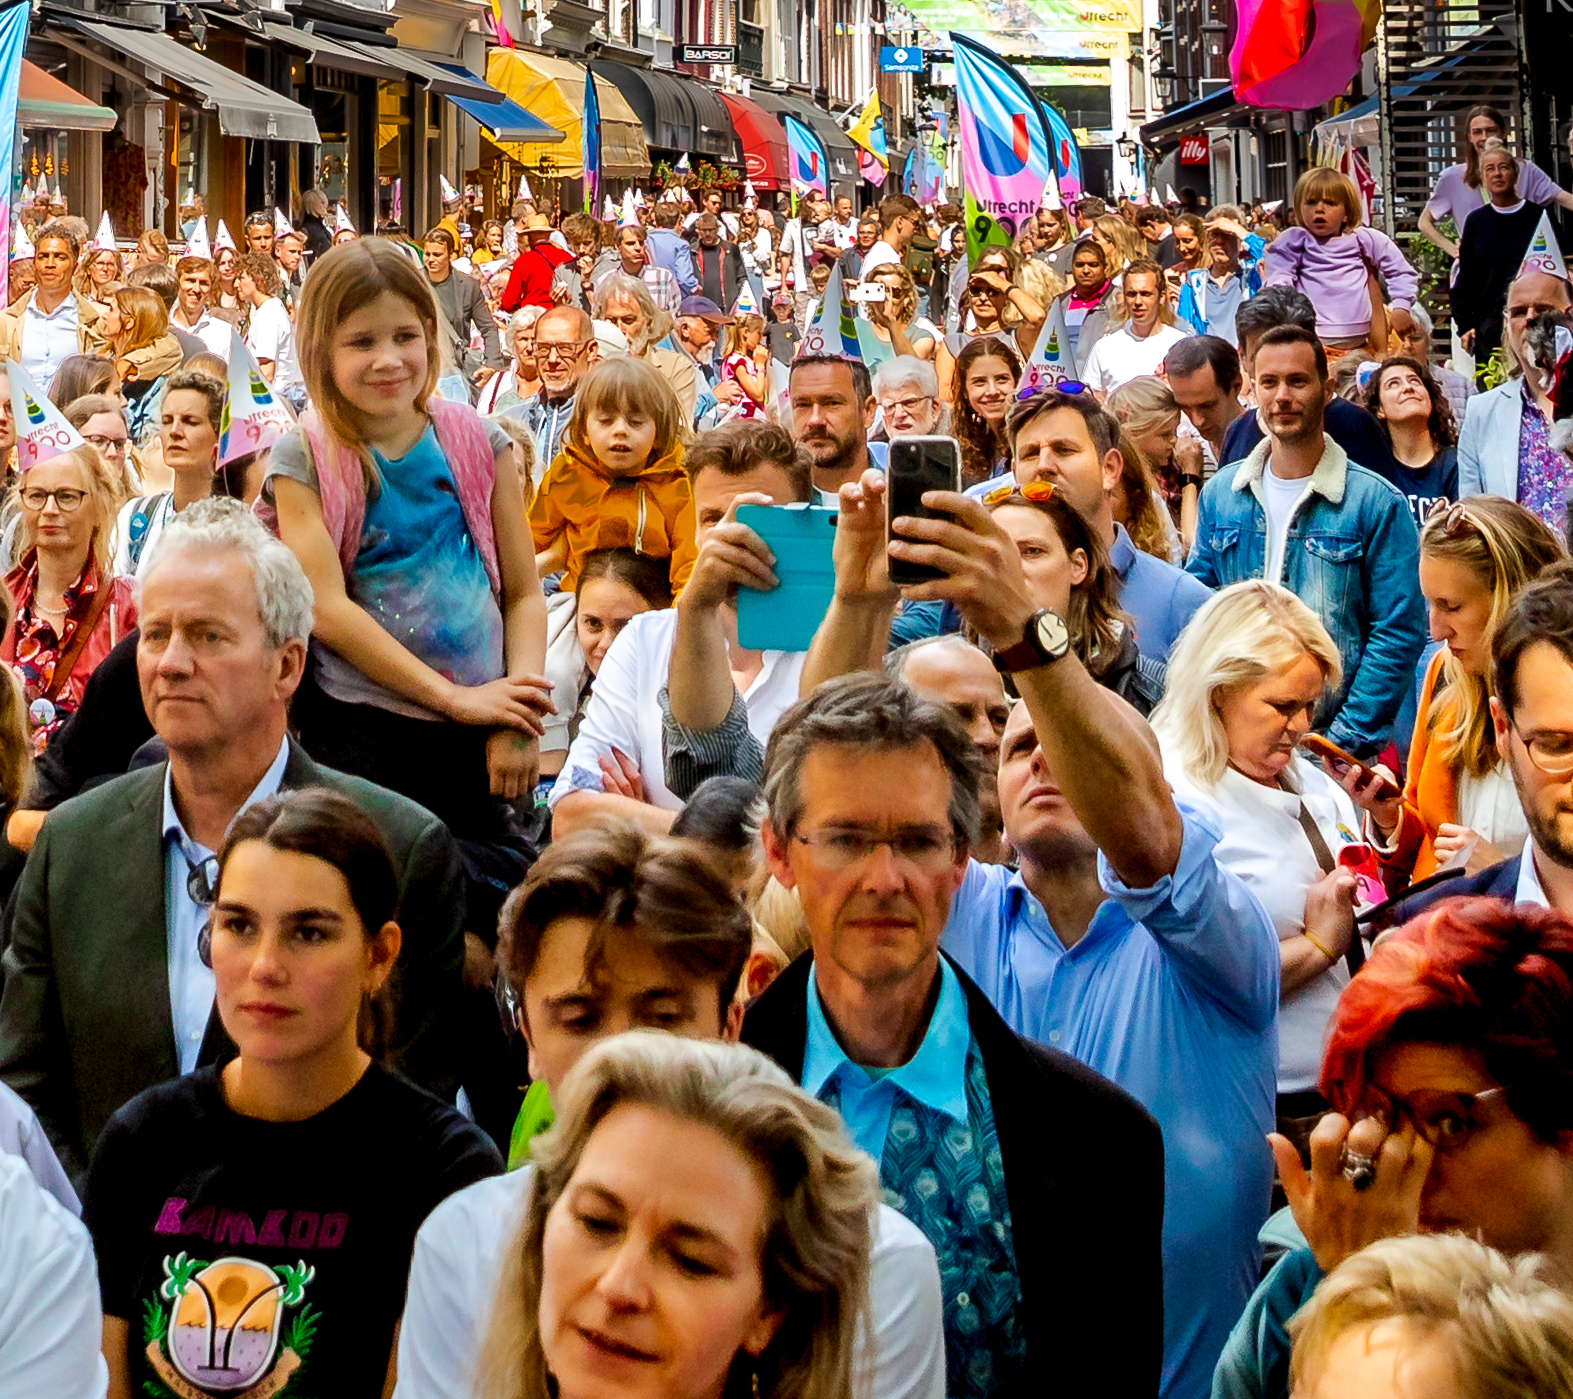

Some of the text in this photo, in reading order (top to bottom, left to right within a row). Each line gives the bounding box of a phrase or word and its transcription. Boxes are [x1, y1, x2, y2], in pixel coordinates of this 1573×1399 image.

[1079, 10, 1129, 22] Utrecht
[883, 63, 920, 72] Samsonite
[1181, 139, 1207, 163] illy
[975, 198, 1036, 214] Utrecht
[1531, 257, 1558, 272] 00
[804, 334, 825, 351] 00
[28, 430, 71, 460] 900
